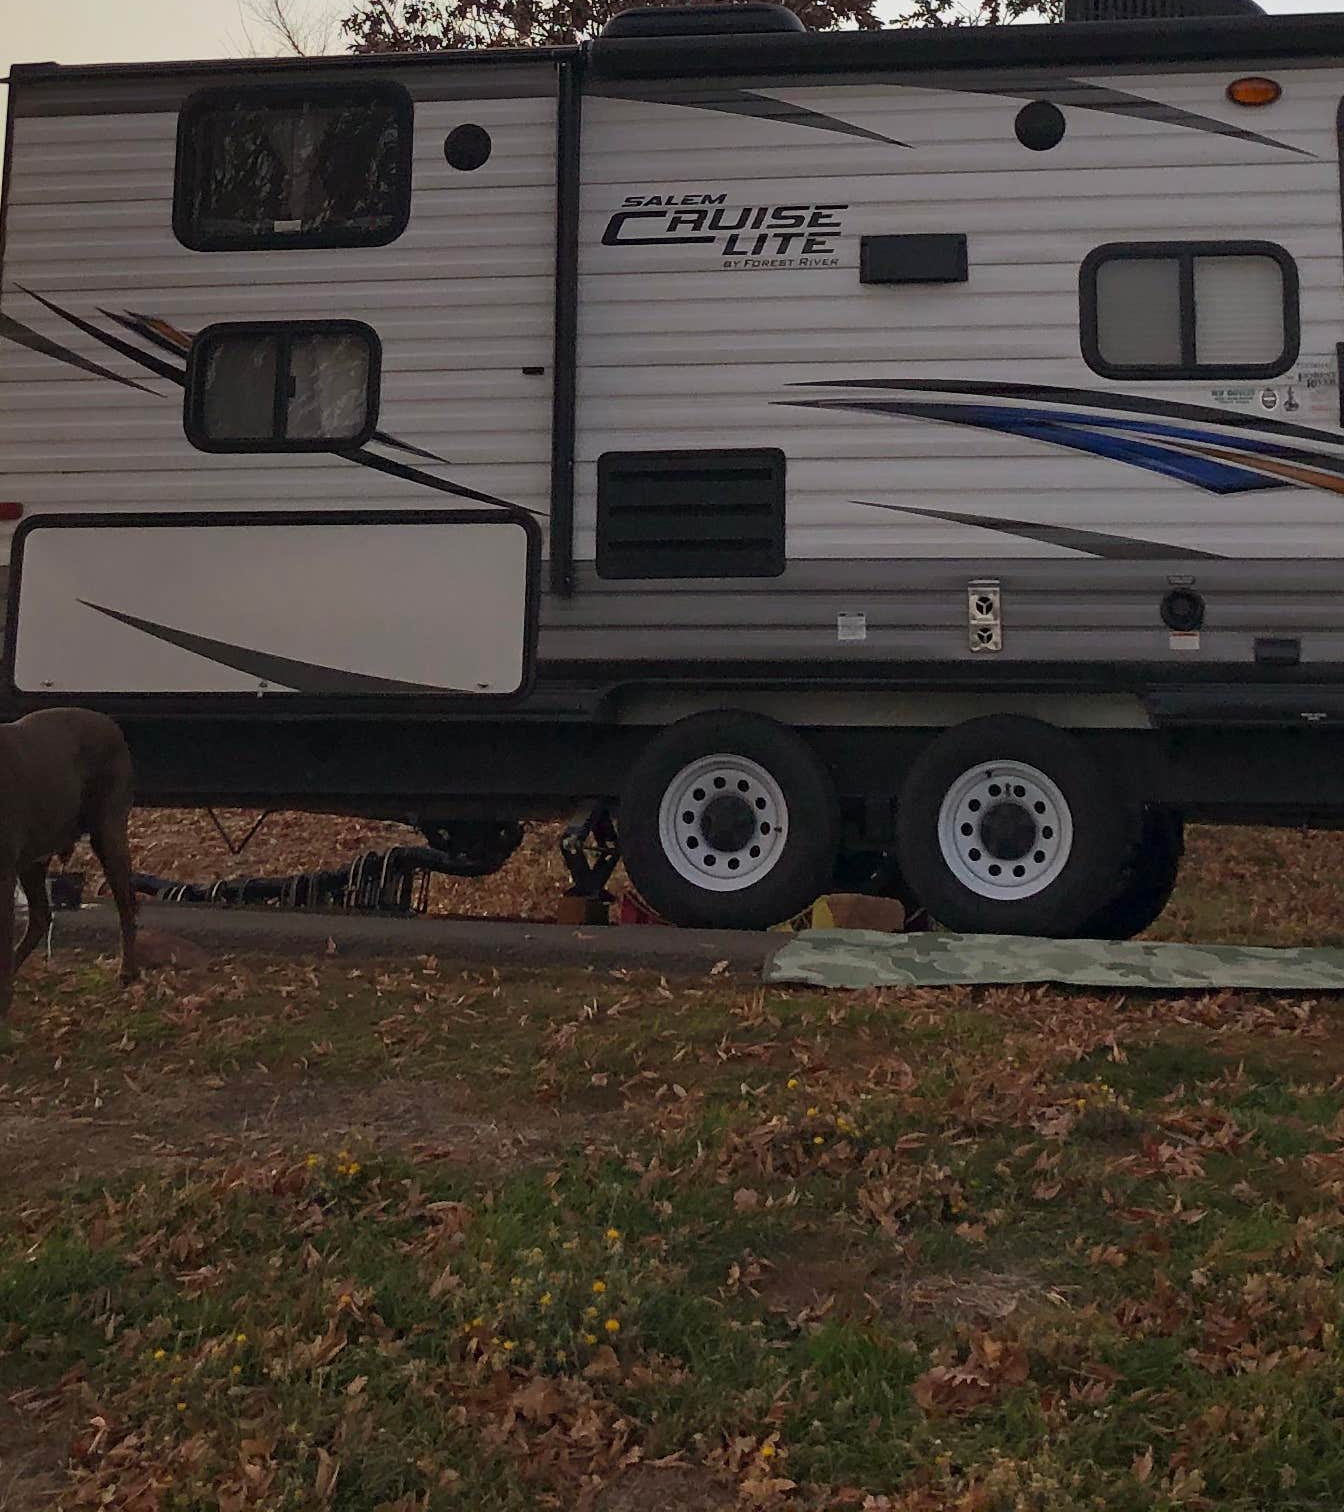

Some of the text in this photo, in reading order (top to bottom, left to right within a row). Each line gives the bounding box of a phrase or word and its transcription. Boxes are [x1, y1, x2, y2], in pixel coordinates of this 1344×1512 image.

[621, 193, 727, 207] SALEM
[601, 204, 849, 246] CRUISE
[722, 232, 841, 256] LITE
[723, 260, 741, 268] BY
[743, 259, 795, 268] FOREST
